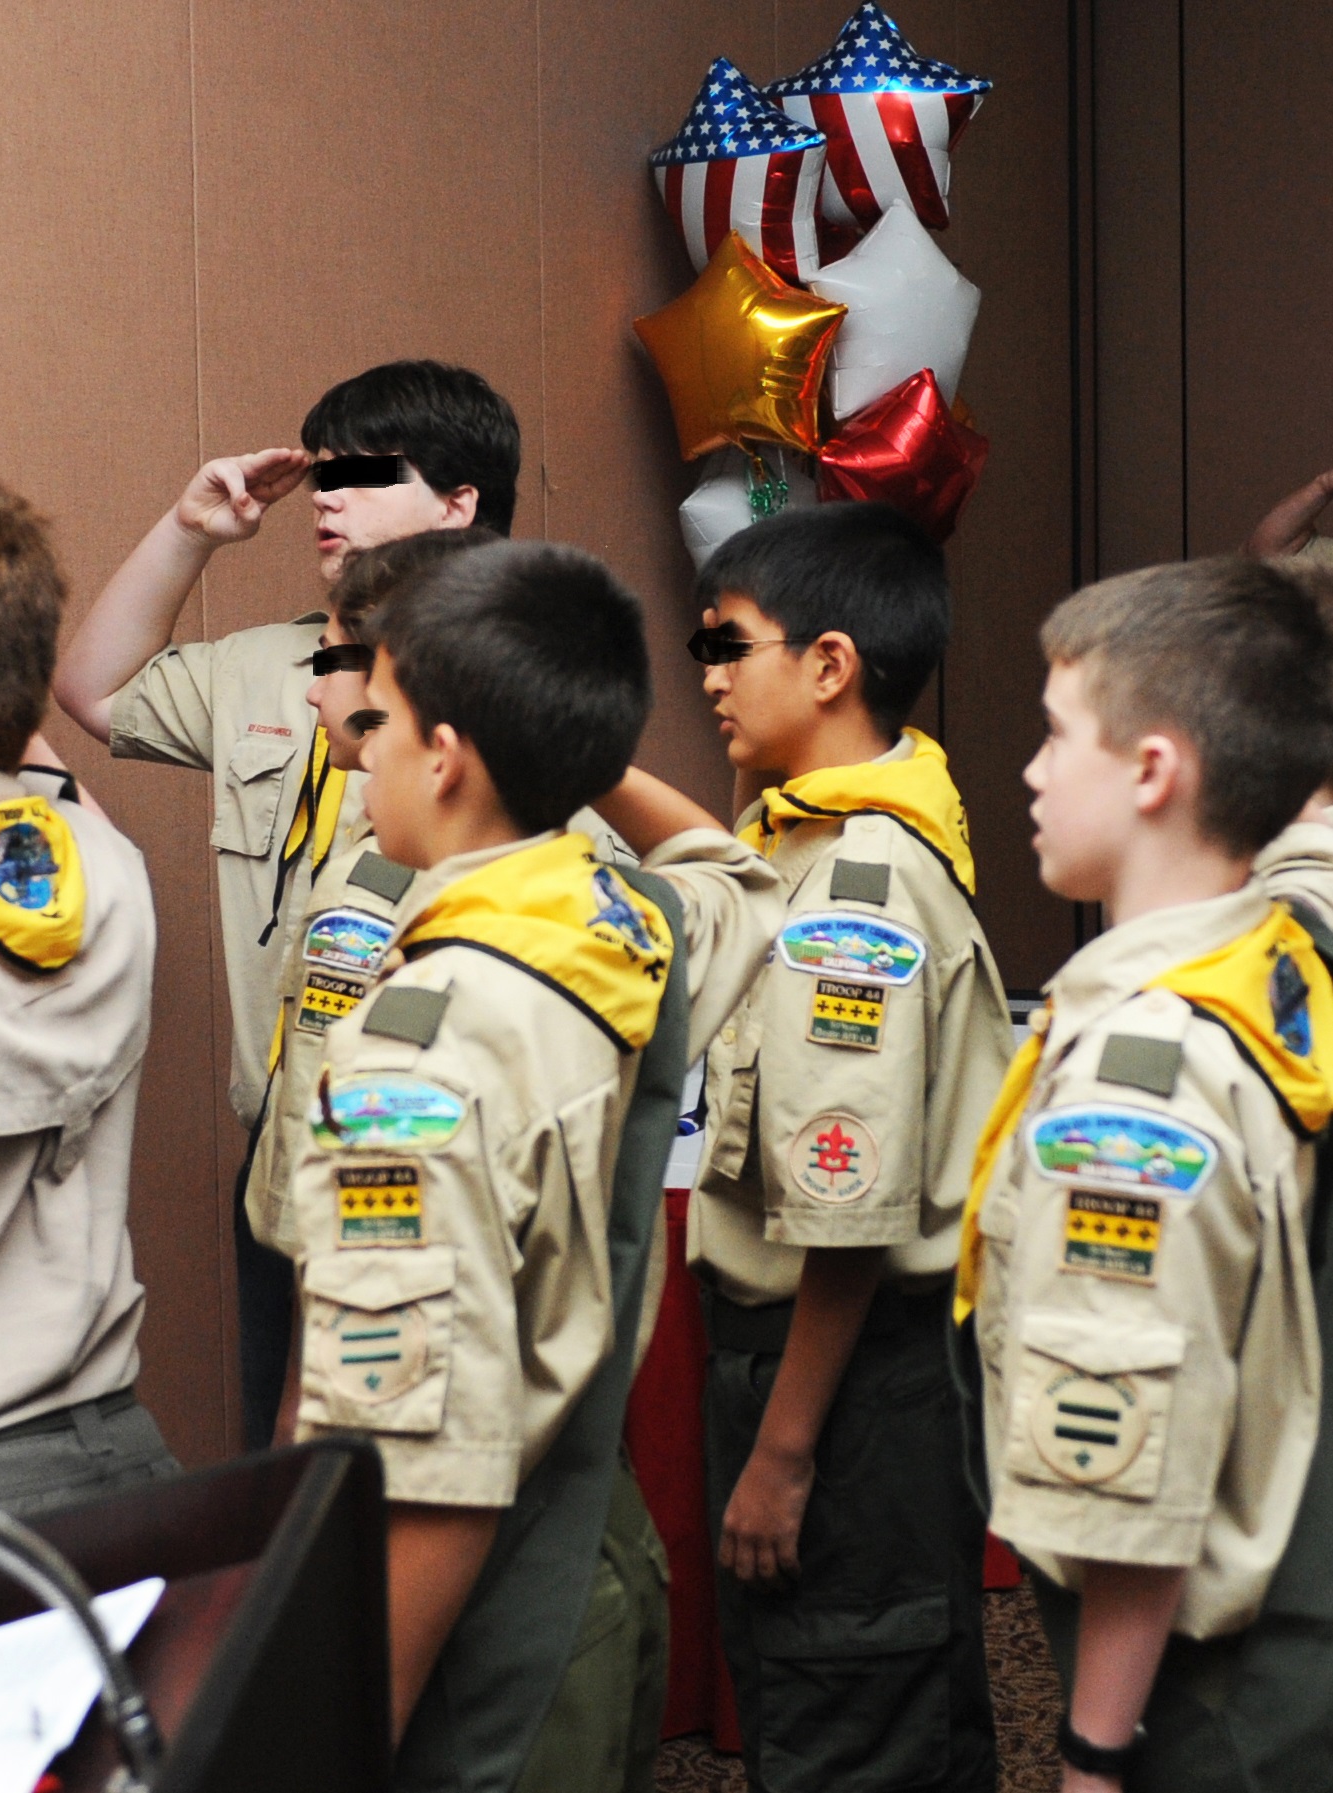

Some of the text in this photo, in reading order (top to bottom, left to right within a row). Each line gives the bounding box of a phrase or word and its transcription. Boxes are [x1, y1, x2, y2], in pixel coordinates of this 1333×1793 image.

[836, 920, 866, 933] EMPIRE
[311, 975, 364, 996] TROOP 44
[821, 982, 880, 1000] TROOP 44
